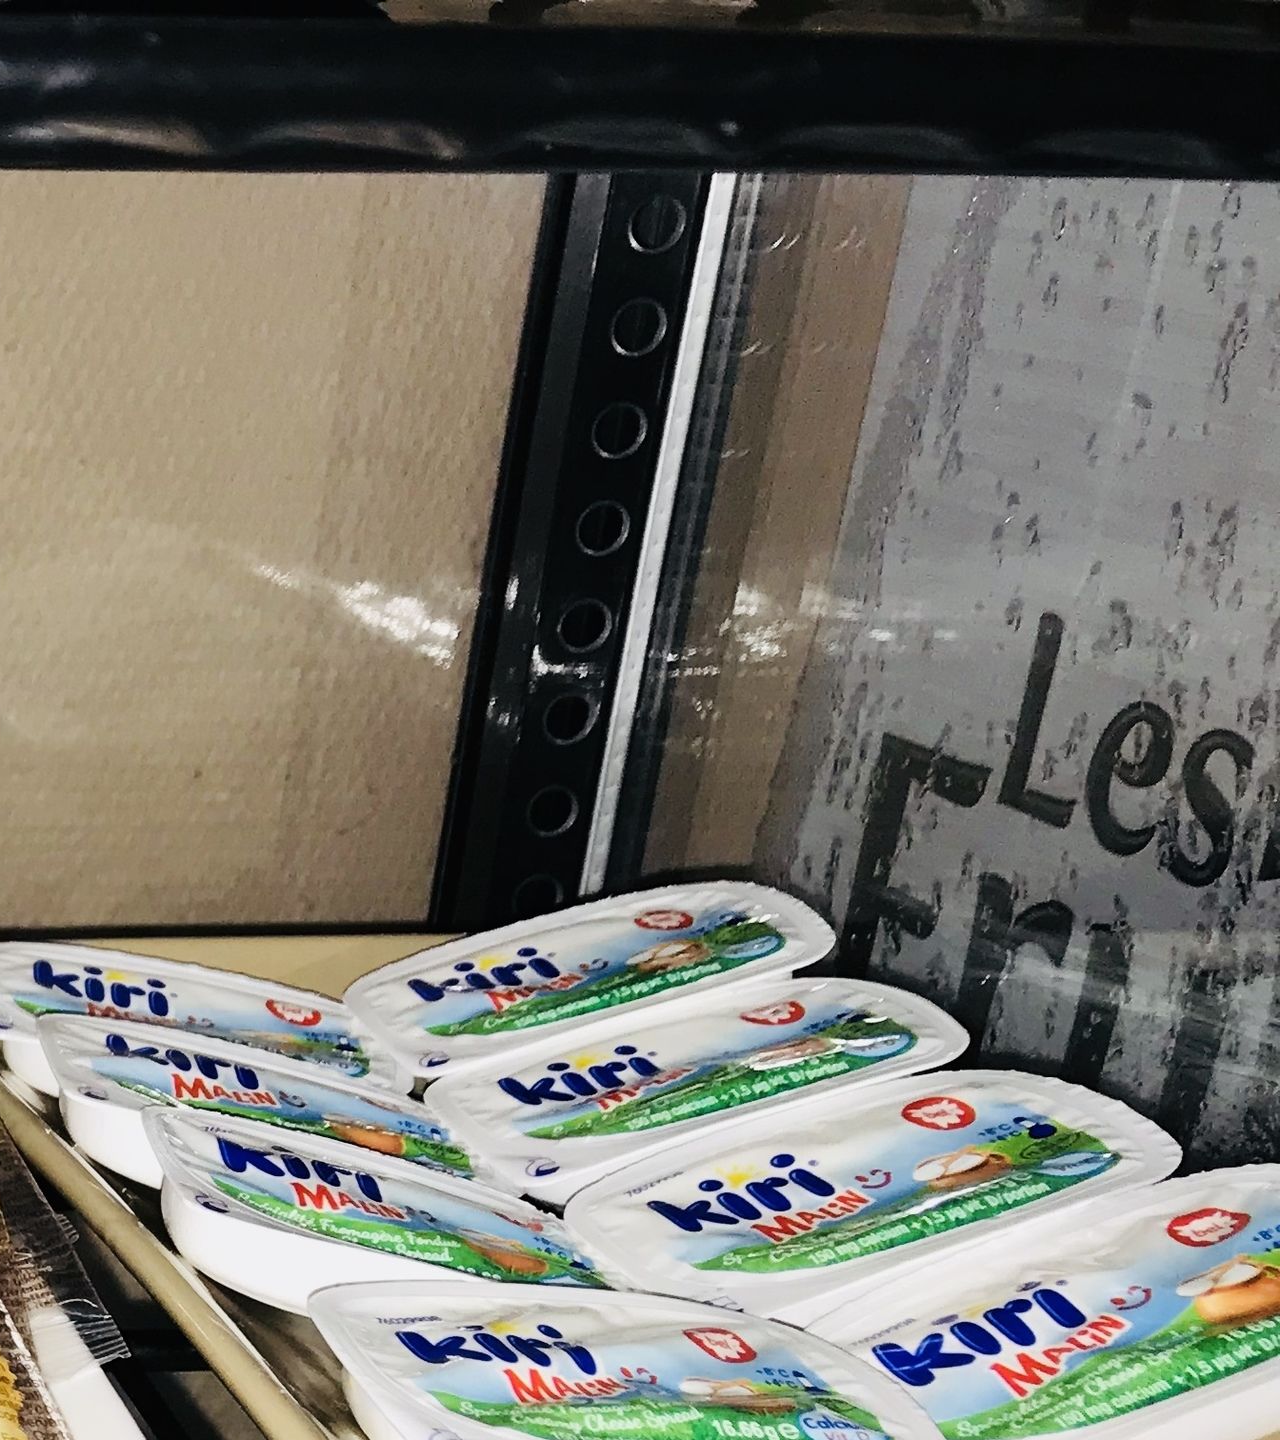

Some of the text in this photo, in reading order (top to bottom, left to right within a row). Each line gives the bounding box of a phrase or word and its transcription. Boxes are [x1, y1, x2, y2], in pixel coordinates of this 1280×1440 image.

[997, 610, 1258, 888] Les
[33, 959, 170, 1018] kiri
[407, 945, 561, 1002] kiri
[106, 1033, 260, 1091] kiri
[498, 1044, 660, 1105] kiri
[217, 1136, 384, 1203] kiri
[646, 1153, 836, 1233] kiri
[395, 1324, 598, 1376] kiri
[872, 1280, 1087, 1387] kiri
